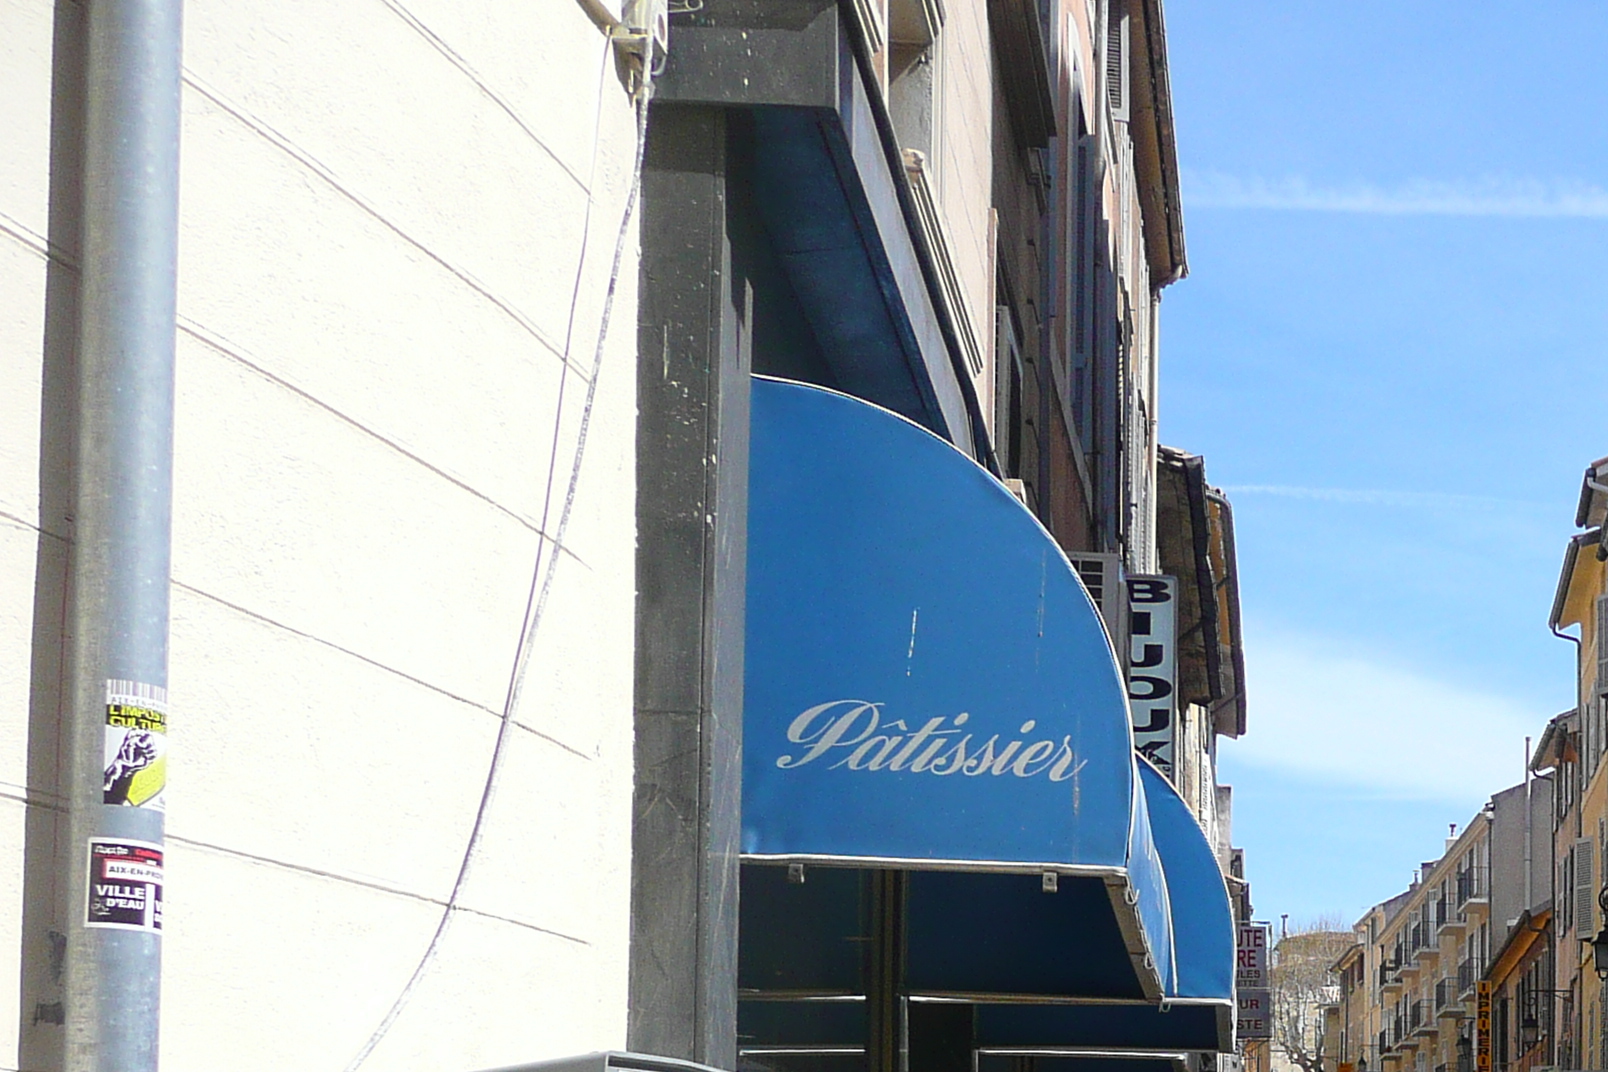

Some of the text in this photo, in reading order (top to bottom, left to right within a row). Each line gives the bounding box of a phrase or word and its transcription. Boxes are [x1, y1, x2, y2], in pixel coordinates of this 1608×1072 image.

[776, 699, 1088, 782] Pâtissier
[95, 884, 145, 900] VILLE
[106, 898, 144, 910] D'EAU
